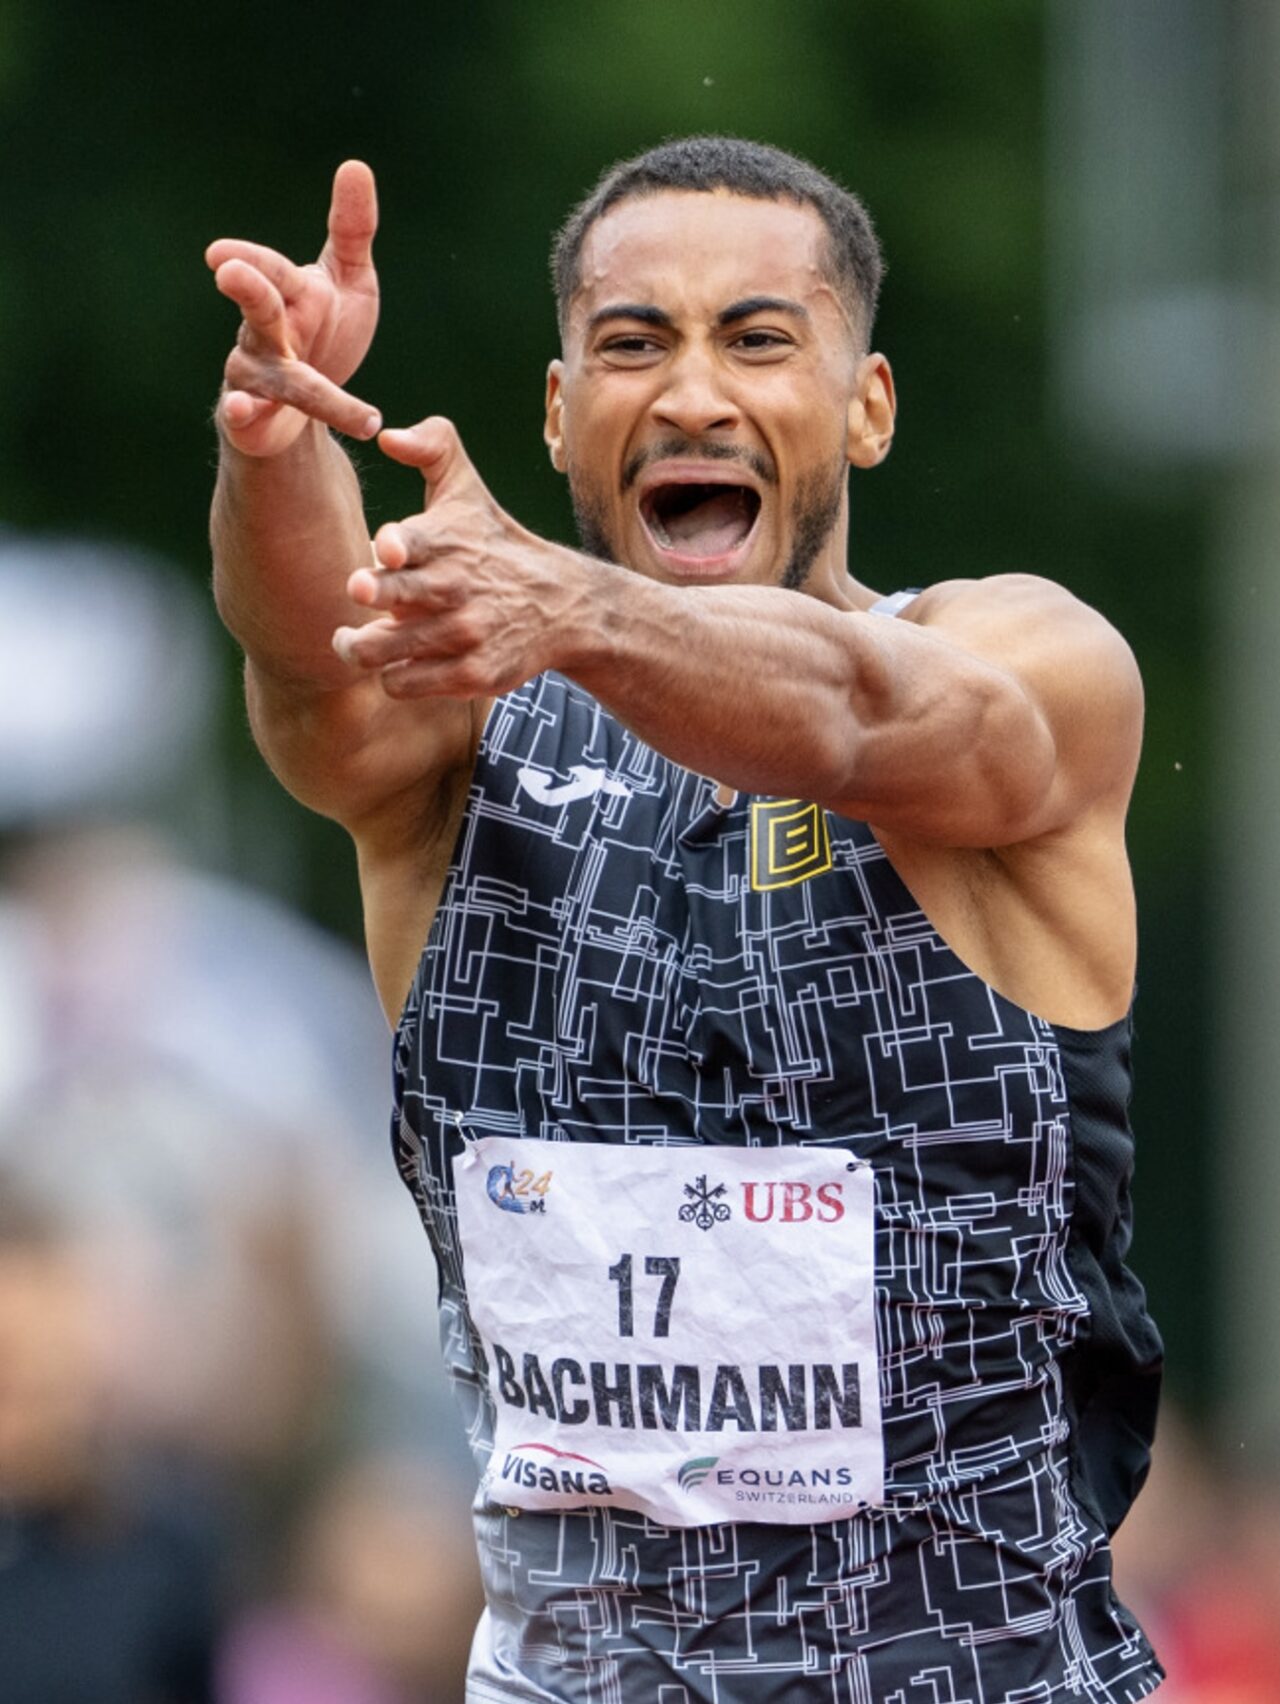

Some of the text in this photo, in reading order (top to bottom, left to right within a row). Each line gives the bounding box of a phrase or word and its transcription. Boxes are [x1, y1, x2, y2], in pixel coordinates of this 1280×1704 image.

[741, 1182, 845, 1223] UBS
[608, 1253, 681, 1338] 17
[492, 1341, 862, 1433] BACHMANN
[717, 1468, 853, 1487] EQUANS
[735, 1490, 854, 1505] SWITZERLAND
